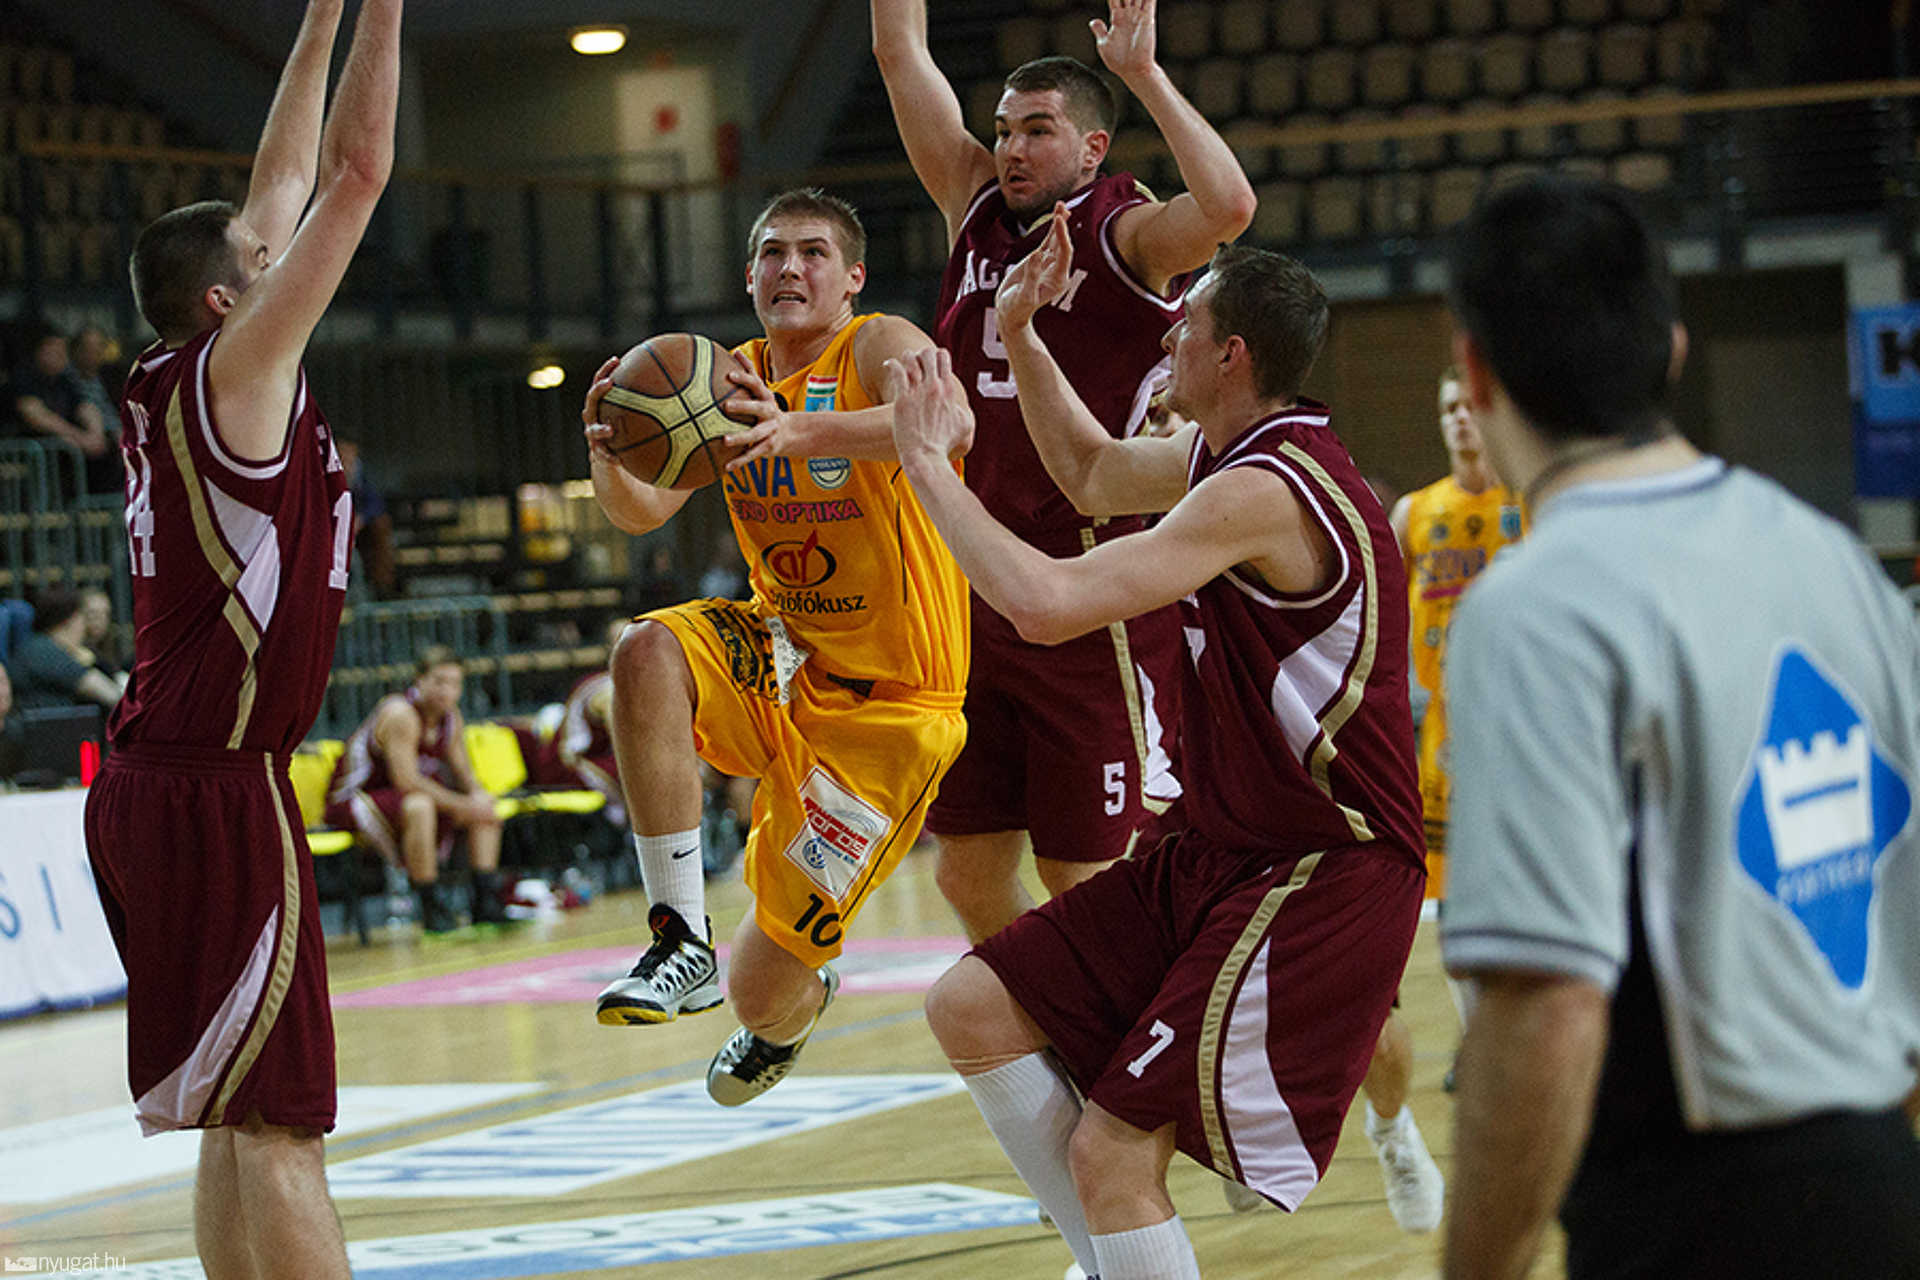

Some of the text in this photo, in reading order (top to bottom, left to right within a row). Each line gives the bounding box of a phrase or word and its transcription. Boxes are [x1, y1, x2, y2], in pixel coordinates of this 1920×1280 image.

[976, 306, 1018, 398] 5
[772, 498, 864, 524] OPTIKA
[1103, 761, 1125, 816] 5
[793, 892, 842, 948] 10
[1126, 1018, 1175, 1079] 7
